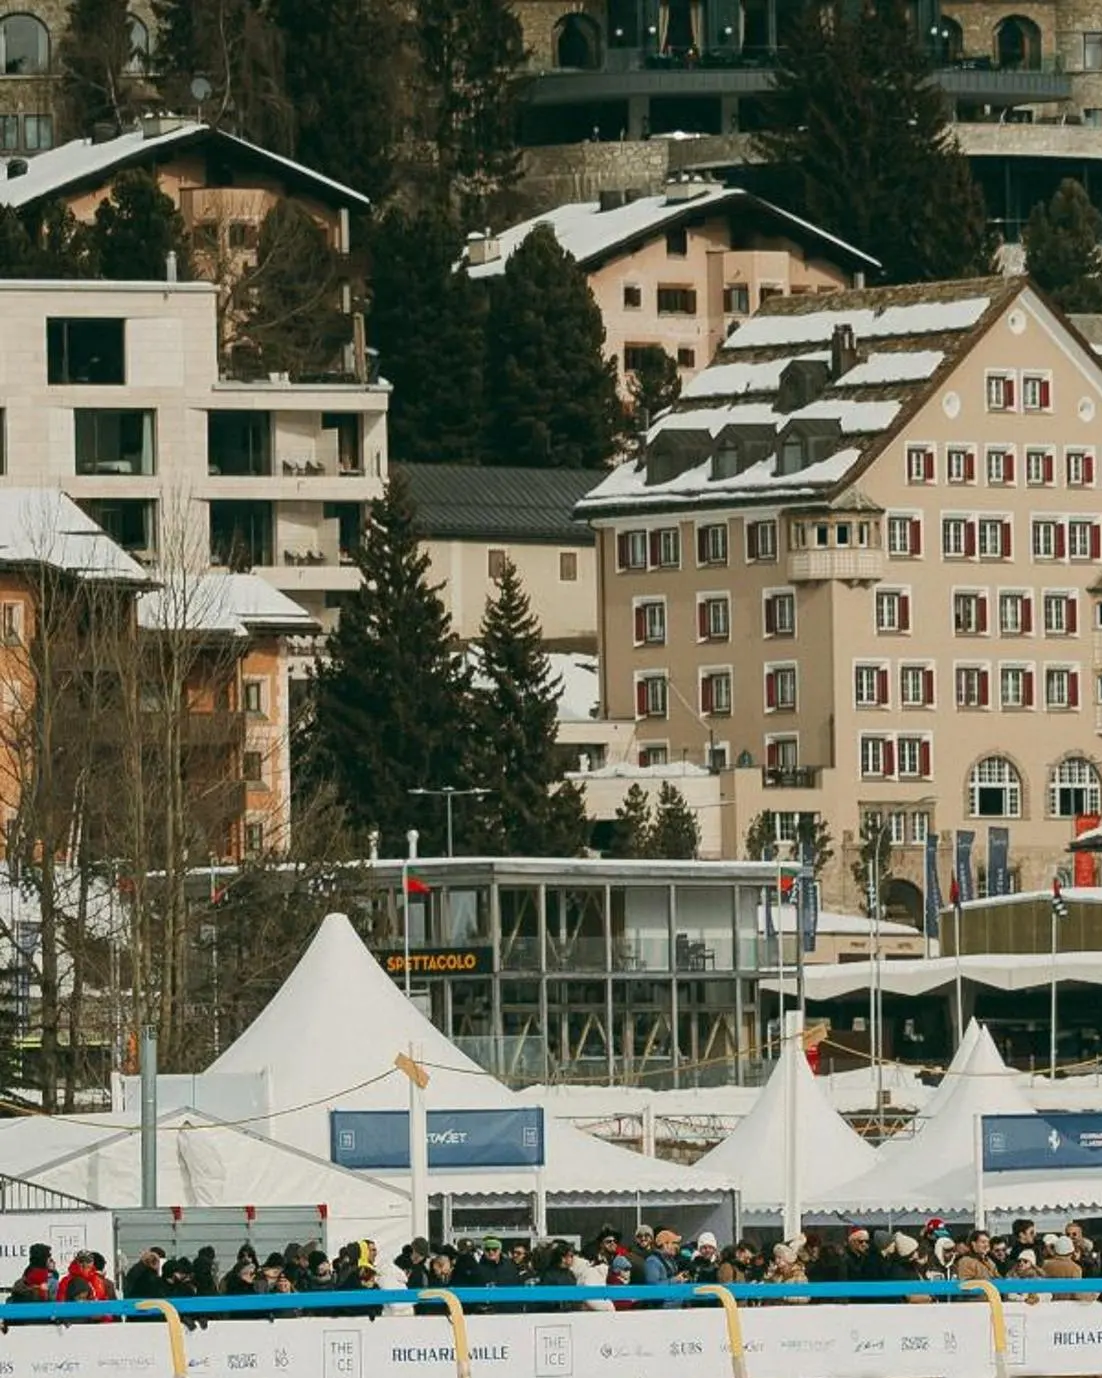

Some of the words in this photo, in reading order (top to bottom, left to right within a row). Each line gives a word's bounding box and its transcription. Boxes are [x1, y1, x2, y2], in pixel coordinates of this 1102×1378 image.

[387, 954, 476, 971] SPETTACOLO
[331, 1342, 353, 1355] THE
[543, 1336, 566, 1349] THE
[545, 1352, 566, 1366] ICE
